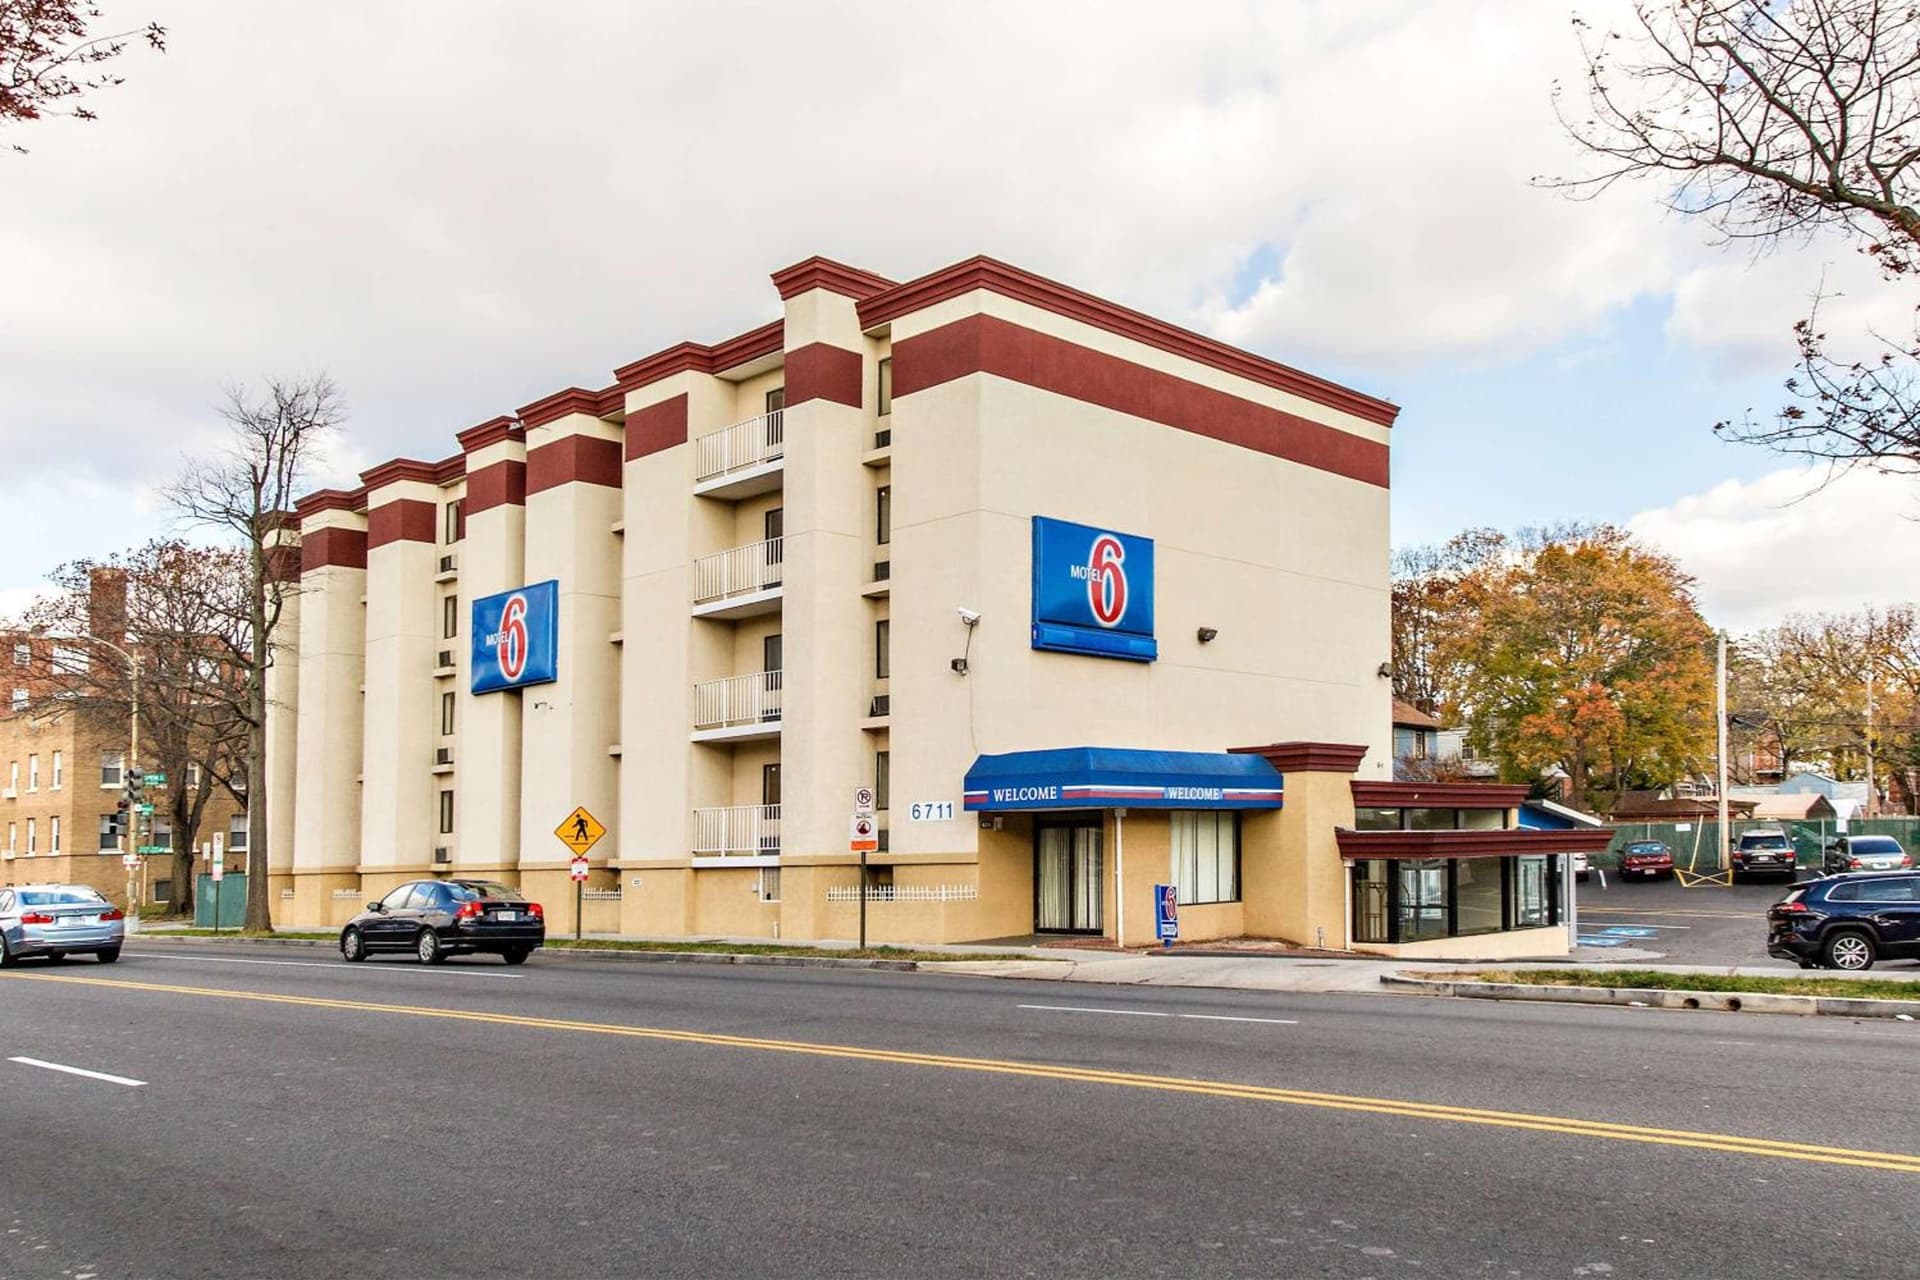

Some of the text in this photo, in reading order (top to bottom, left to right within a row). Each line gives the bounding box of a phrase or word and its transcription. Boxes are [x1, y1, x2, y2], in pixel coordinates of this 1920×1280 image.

[1071, 534, 1128, 628] MOTEL 6
[486, 593, 528, 682] MOTEL 6
[993, 786, 1057, 802] WELCOME
[1168, 787, 1219, 800] WELCOME
[912, 803, 952, 819] 6711
